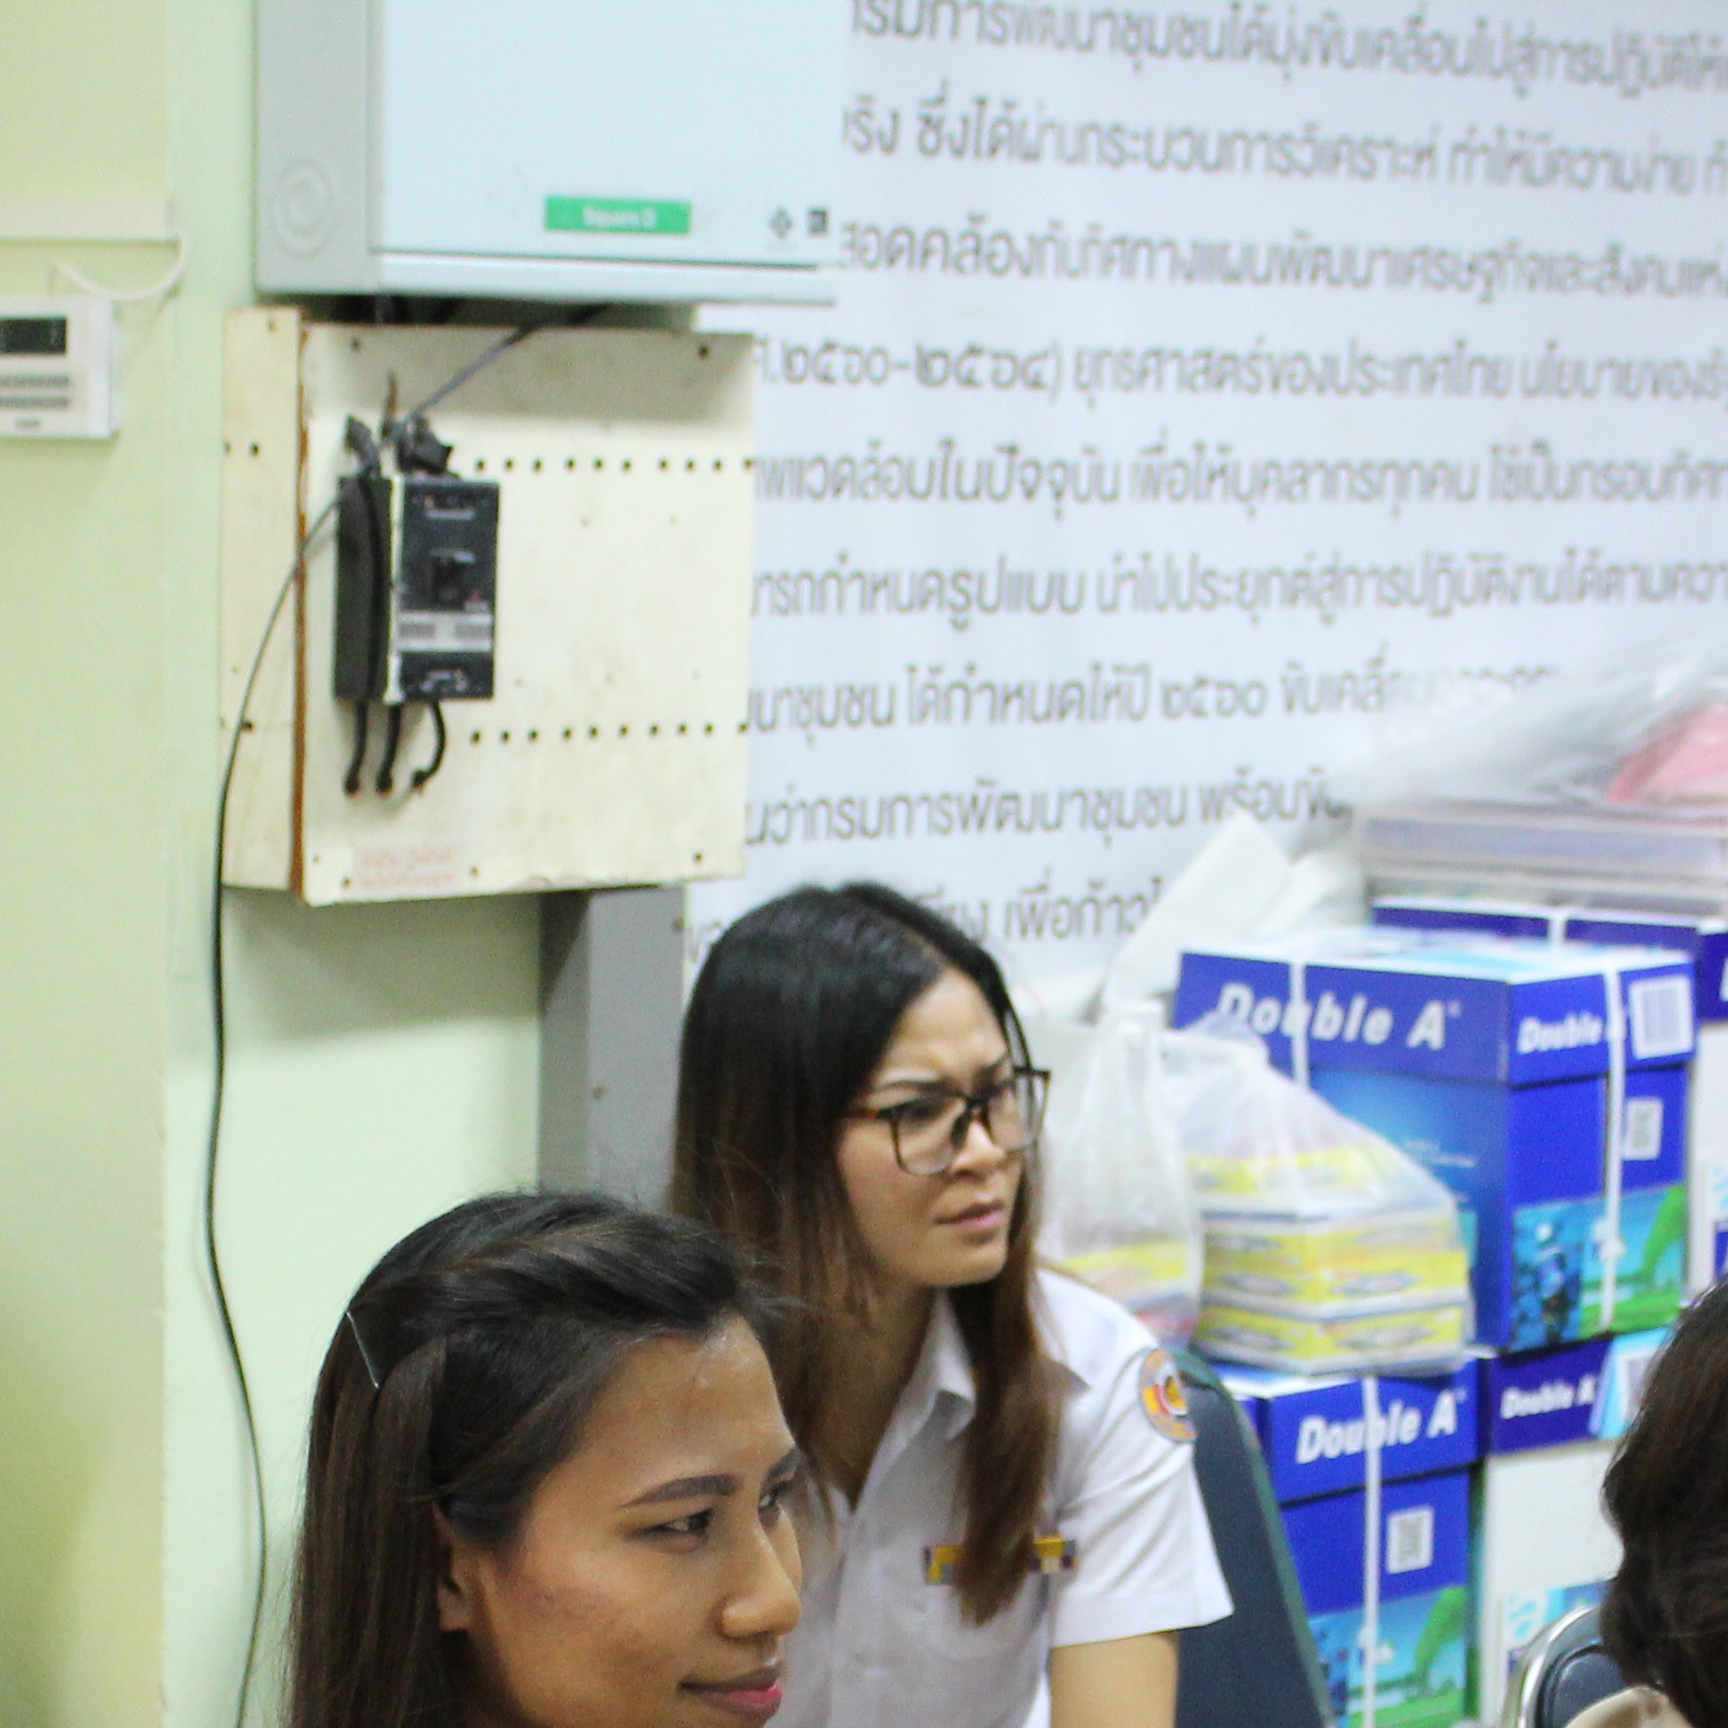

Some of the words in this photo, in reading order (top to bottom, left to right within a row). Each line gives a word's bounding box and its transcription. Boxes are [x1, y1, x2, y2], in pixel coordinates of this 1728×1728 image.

[1404, 999, 1447, 1051] A
[1516, 1011, 1603, 1055] Double
[1426, 1388, 1459, 1439] A
[1499, 1378, 1573, 1420] Double
